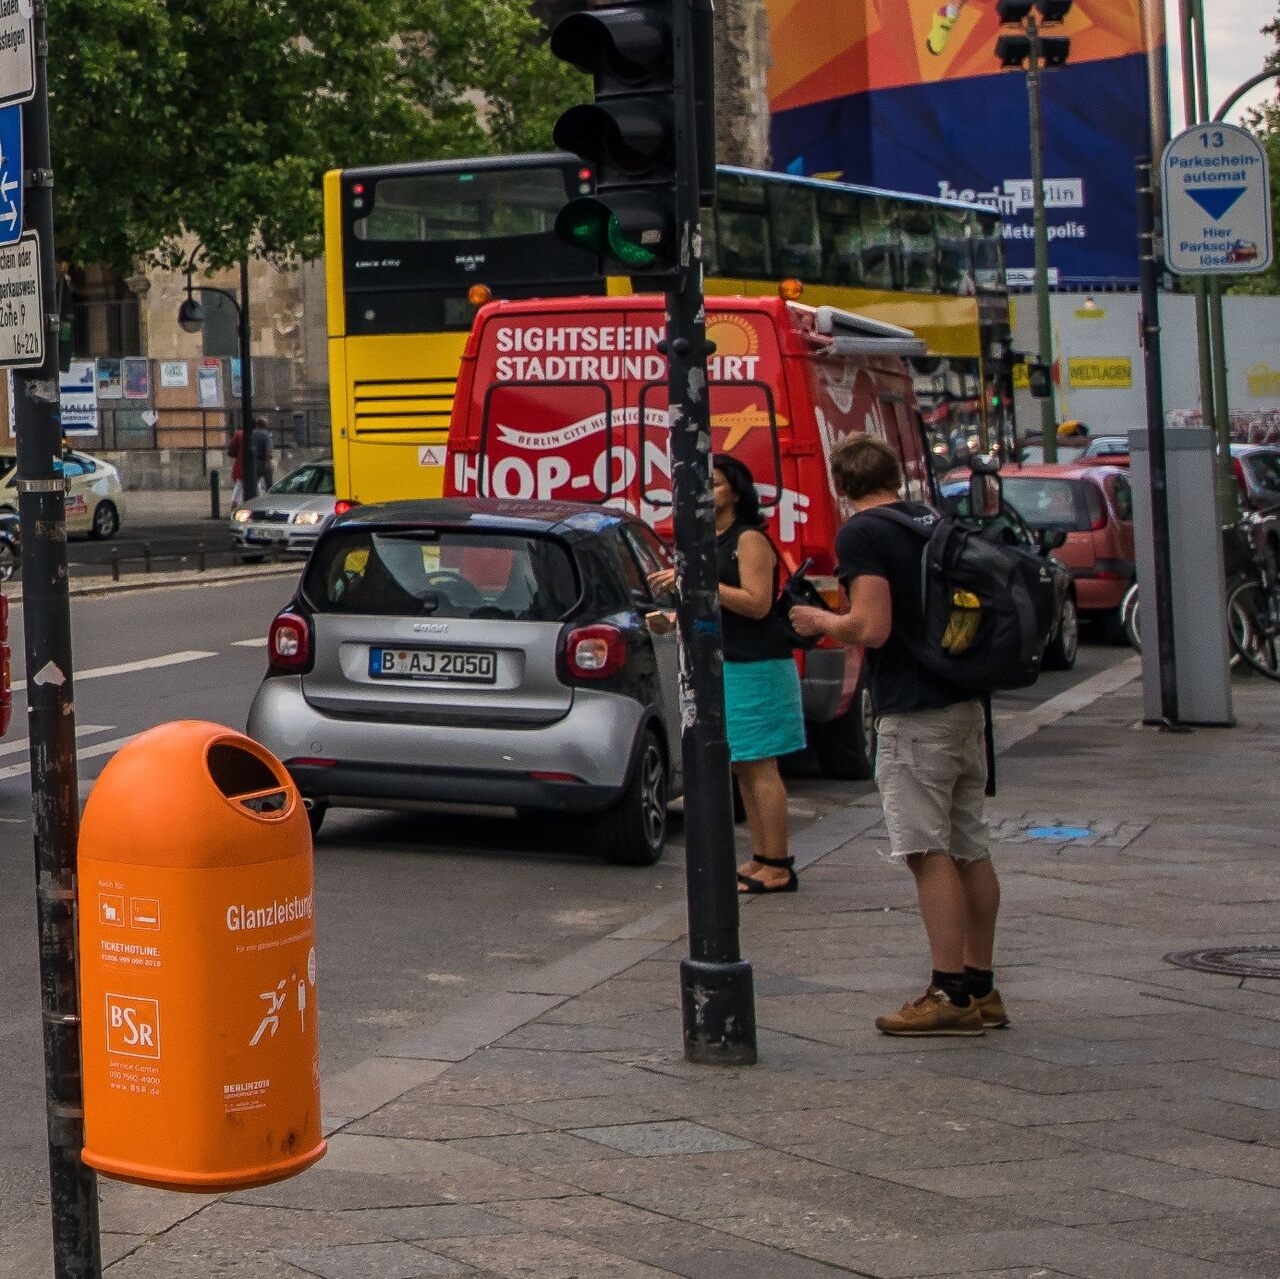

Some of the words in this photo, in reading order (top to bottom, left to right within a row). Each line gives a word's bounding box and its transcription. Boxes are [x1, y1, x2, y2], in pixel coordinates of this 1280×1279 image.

[1200, 131, 1224, 148] 13
[1169, 154, 1260, 168] Parkschein-
[1183, 170, 1246, 183] automat
[1021, 186, 1074, 202] Blin
[1002, 222, 1086, 241] Metrpolis
[1203, 227, 1232, 237] Hier
[17, 248, 32, 268] oder
[0, 308, 19, 329] Zone
[20, 303, 27, 323] 9
[13, 332, 39, 355] 16-22h
[496, 326, 666, 352] SIGHTSEEIN
[496, 355, 759, 381] STADTRUNDHRT
[383, 652, 395, 670] B
[409, 654, 435, 672] AJ
[440, 655, 491, 675] 2050
[111, 1005, 154, 1047] BSR
